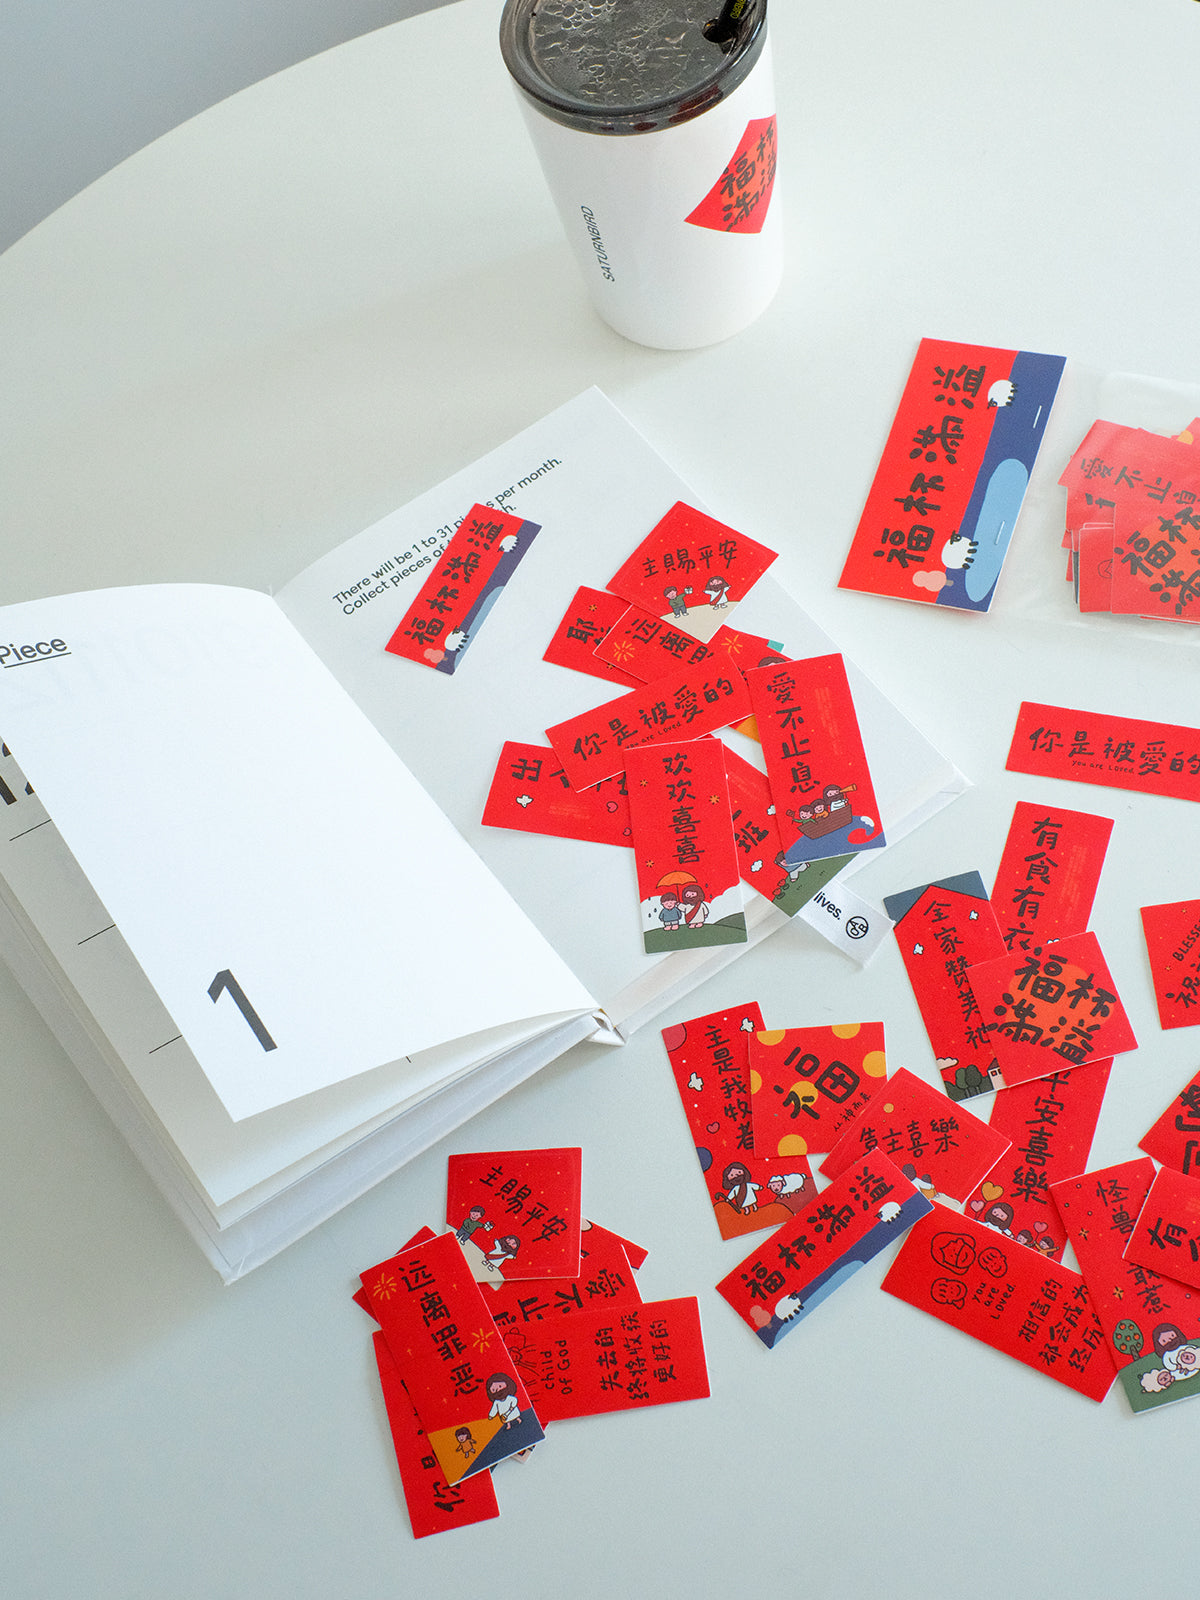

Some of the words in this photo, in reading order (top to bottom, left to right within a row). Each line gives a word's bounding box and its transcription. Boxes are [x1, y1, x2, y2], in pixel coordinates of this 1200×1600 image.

[581, 205, 615, 282] SATURNBIRD
[332, 575, 372, 605] There
[371, 559, 395, 579] will
[394, 549, 413, 565] be
[412, 543, 421, 553] 1
[421, 535, 437, 549] to
[437, 525, 453, 539] 31
[494, 485, 516, 506] per
[517, 457, 563, 489] month.
[343, 580, 390, 616] Collect
[390, 555, 432, 588] pieces
[433, 542, 446, 558] of
[662, 752, 705, 865] 欢欢喜喜
[813, 891, 842, 920] lives.
[207, 968, 278, 1052] 1
[1165, 952, 1200, 1008] 祝
[773, 1046, 860, 1120] 福
[1018, 1278, 1063, 1343] 相信的
[555, 1339, 571, 1371] God
[594, 1327, 623, 1392] 失去的
[649, 1319, 677, 1383] 更好的
